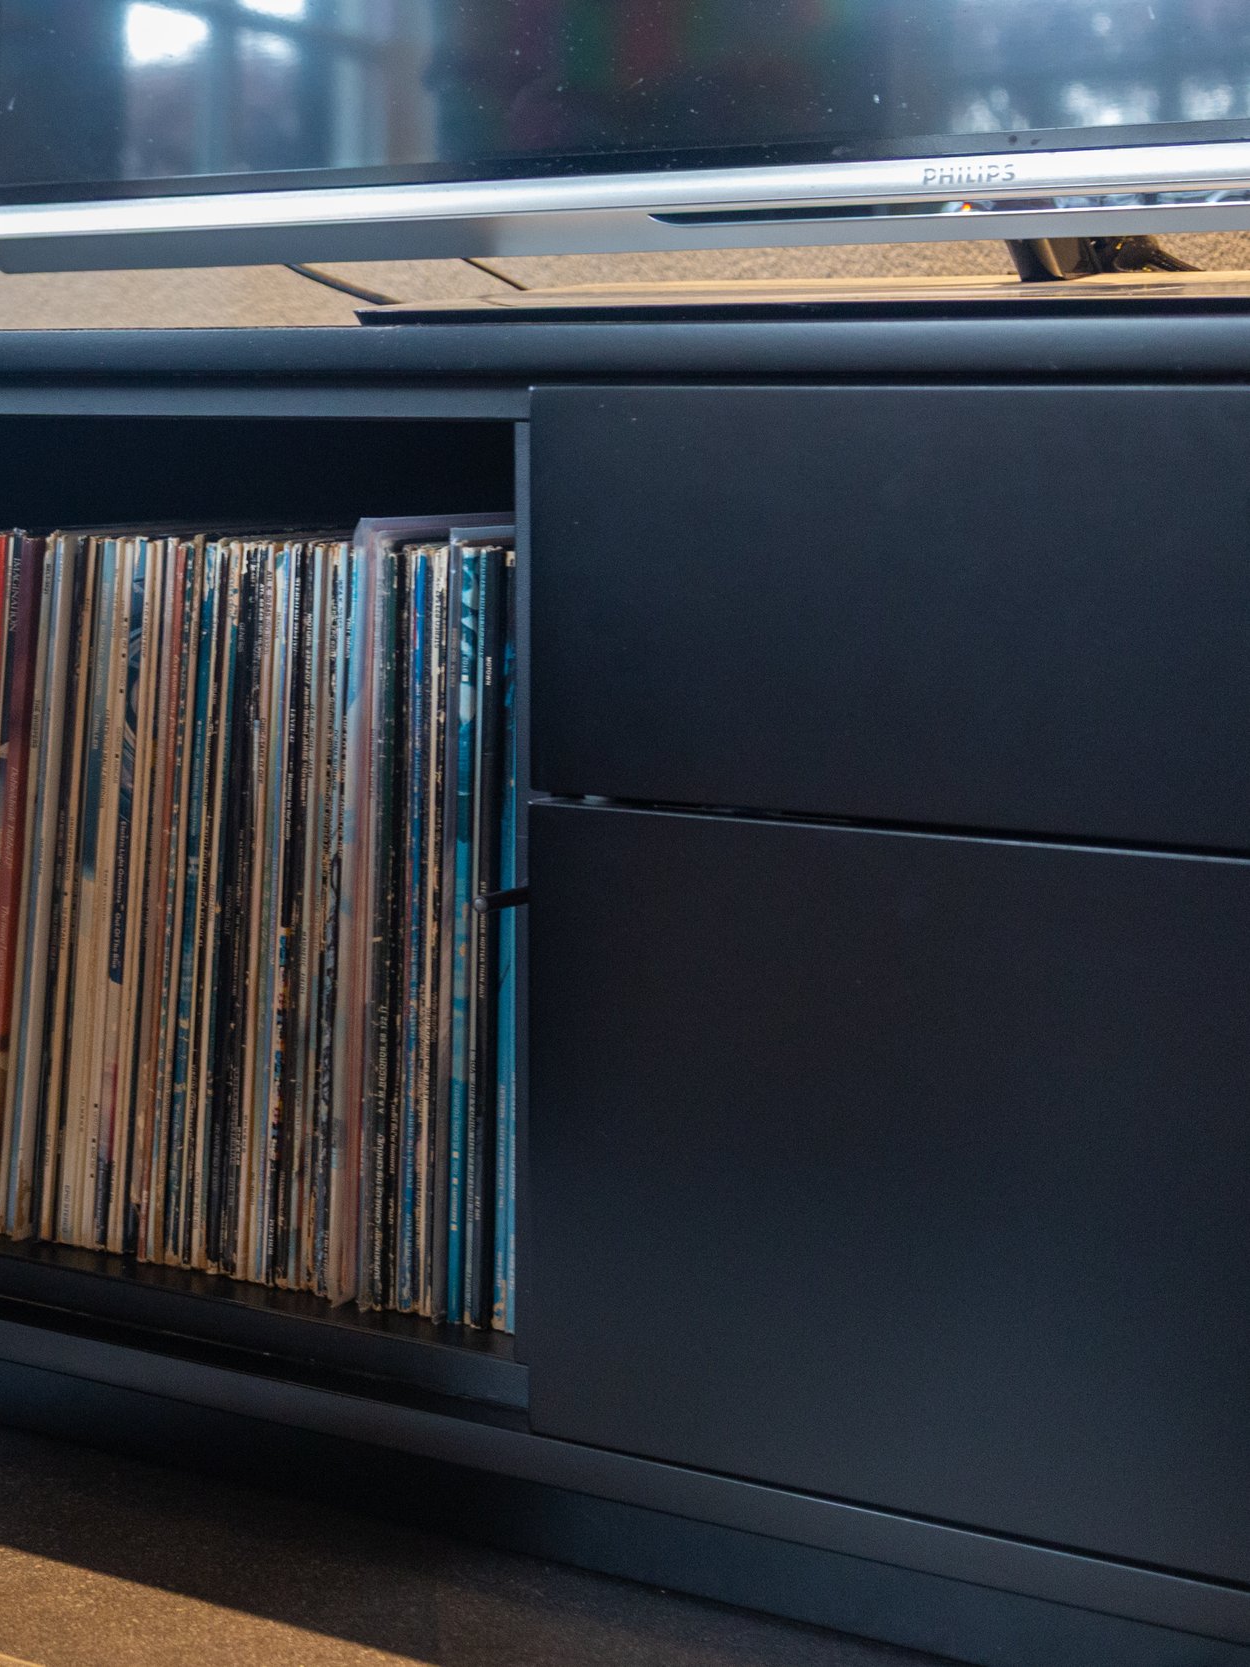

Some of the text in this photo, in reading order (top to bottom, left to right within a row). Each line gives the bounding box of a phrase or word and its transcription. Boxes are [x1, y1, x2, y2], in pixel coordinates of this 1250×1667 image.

[923, 164, 1015, 185] PHILIPS
[10, 558, 22, 632] IMAGINATION
[237, 622, 246, 653] GENESIS
[485, 656, 493, 686] MOTOWN
[33, 699, 41, 713] THE
[31, 714, 40, 749] WHISPERS
[93, 714, 101, 749] THRILLER
[301, 736, 309, 761] JARRE
[119, 821, 127, 847] Electric
[117, 848, 126, 867] Light
[116, 868, 125, 903] Orchestra
[114, 912, 122, 925] Out
[112, 954, 120, 969] Blue
[499, 1084, 507, 1119] MERCURY
[376, 1133, 385, 1170] CENTURY
[374, 1186, 383, 1198] OF
[450, 1187, 458, 1223] MERCURY
[373, 1199, 382, 1224] CRIME
[373, 1228, 381, 1280] SUPERTRAMP
